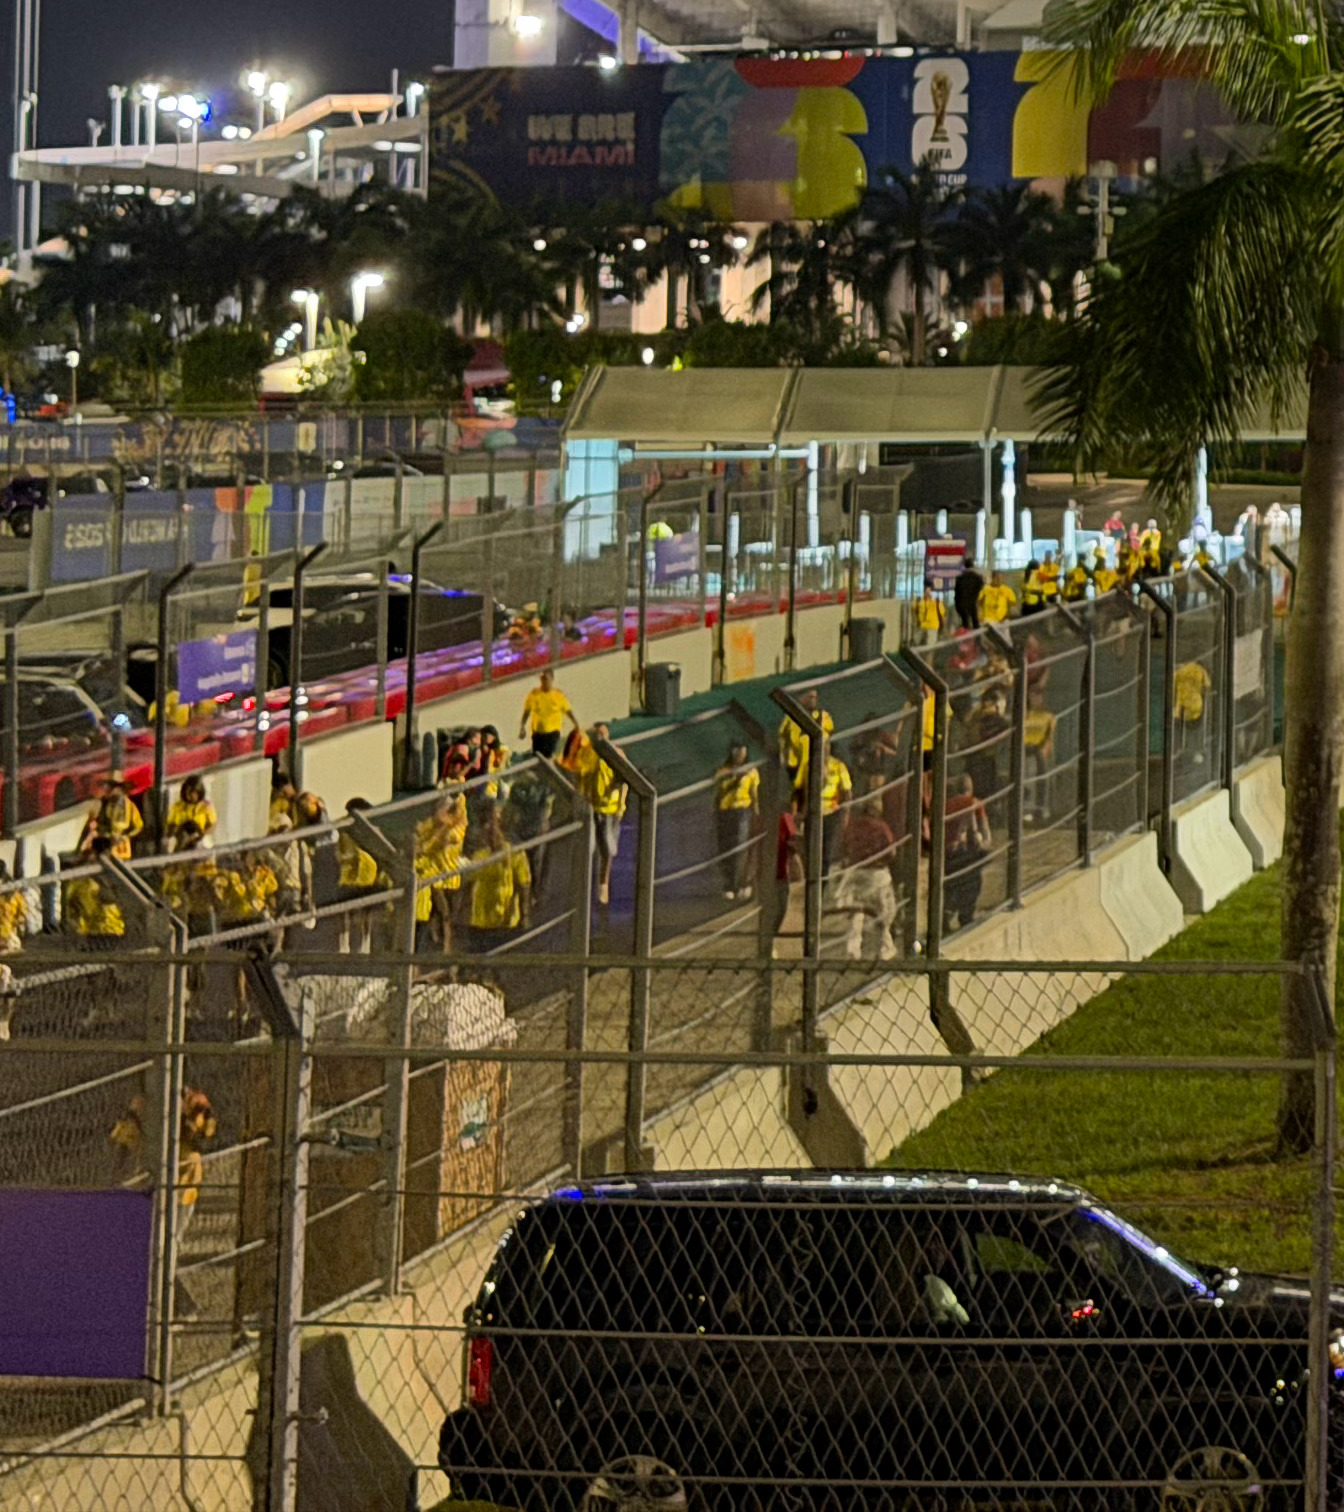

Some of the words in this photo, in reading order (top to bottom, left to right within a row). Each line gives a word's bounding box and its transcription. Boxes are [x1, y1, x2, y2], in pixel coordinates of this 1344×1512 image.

[527, 113, 573, 141] WE
[577, 111, 636, 141] ARE
[527, 144, 636, 168] MIAMI
